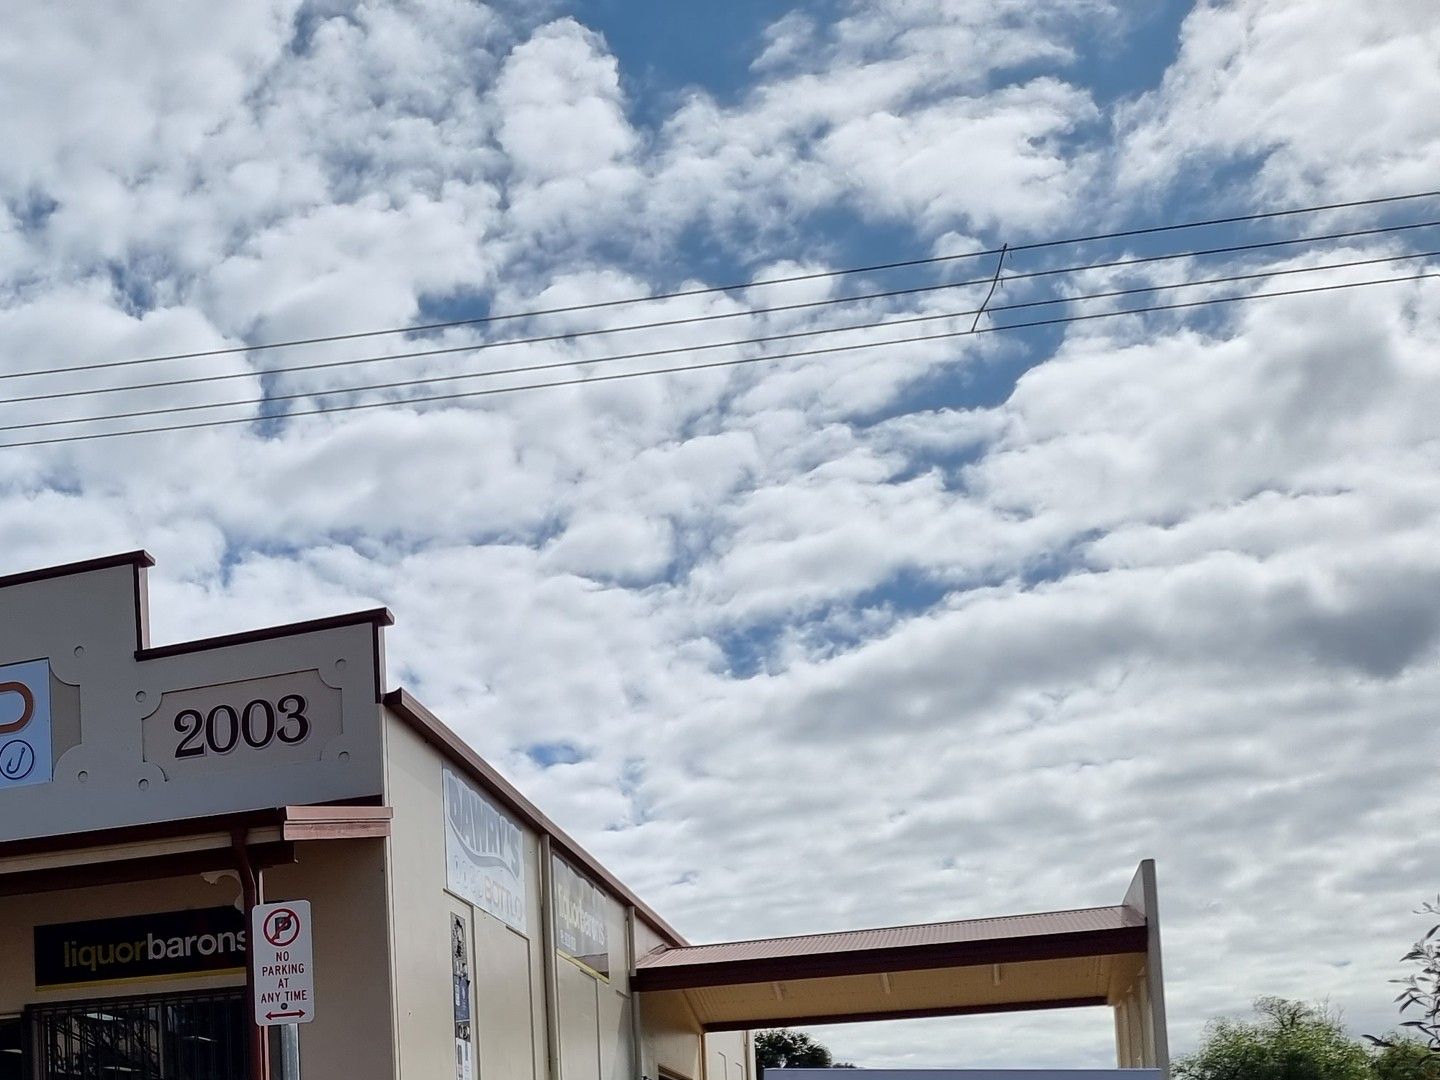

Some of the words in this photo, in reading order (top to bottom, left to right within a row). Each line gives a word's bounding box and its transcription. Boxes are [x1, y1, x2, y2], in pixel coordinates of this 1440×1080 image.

[173, 694, 309, 760] 2003
[275, 951, 290, 962] NO
[262, 963, 305, 977] PARKING
[277, 977, 289, 989] AT
[261, 992, 281, 1004] ANY
[284, 990, 308, 1001] TIME
